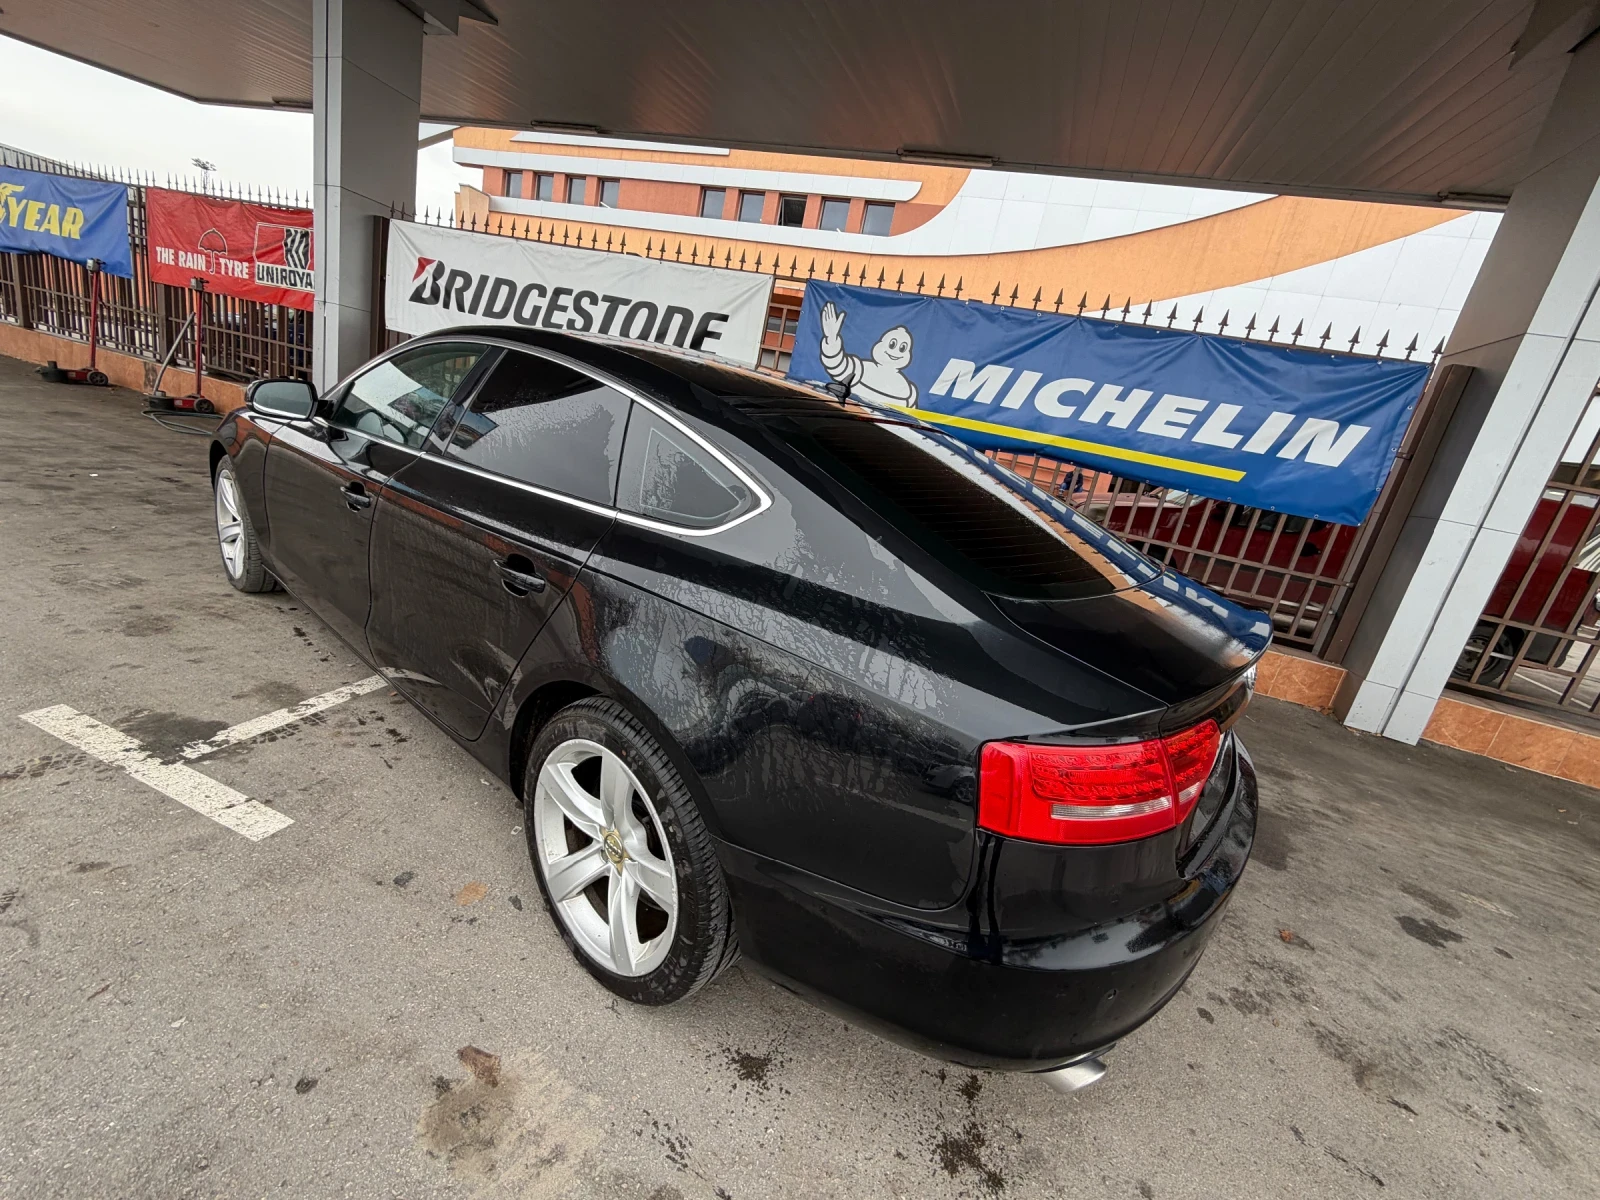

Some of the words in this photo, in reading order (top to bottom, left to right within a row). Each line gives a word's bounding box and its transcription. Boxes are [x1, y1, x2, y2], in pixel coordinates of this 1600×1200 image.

[156, 246, 175, 265] THE
[178, 251, 206, 271] RAIN
[219, 257, 249, 279] TYRE
[256, 264, 315, 290] UNIROYA
[408, 256, 730, 354] BRIDGESTONE
[929, 358, 1371, 468] MICHELIN
